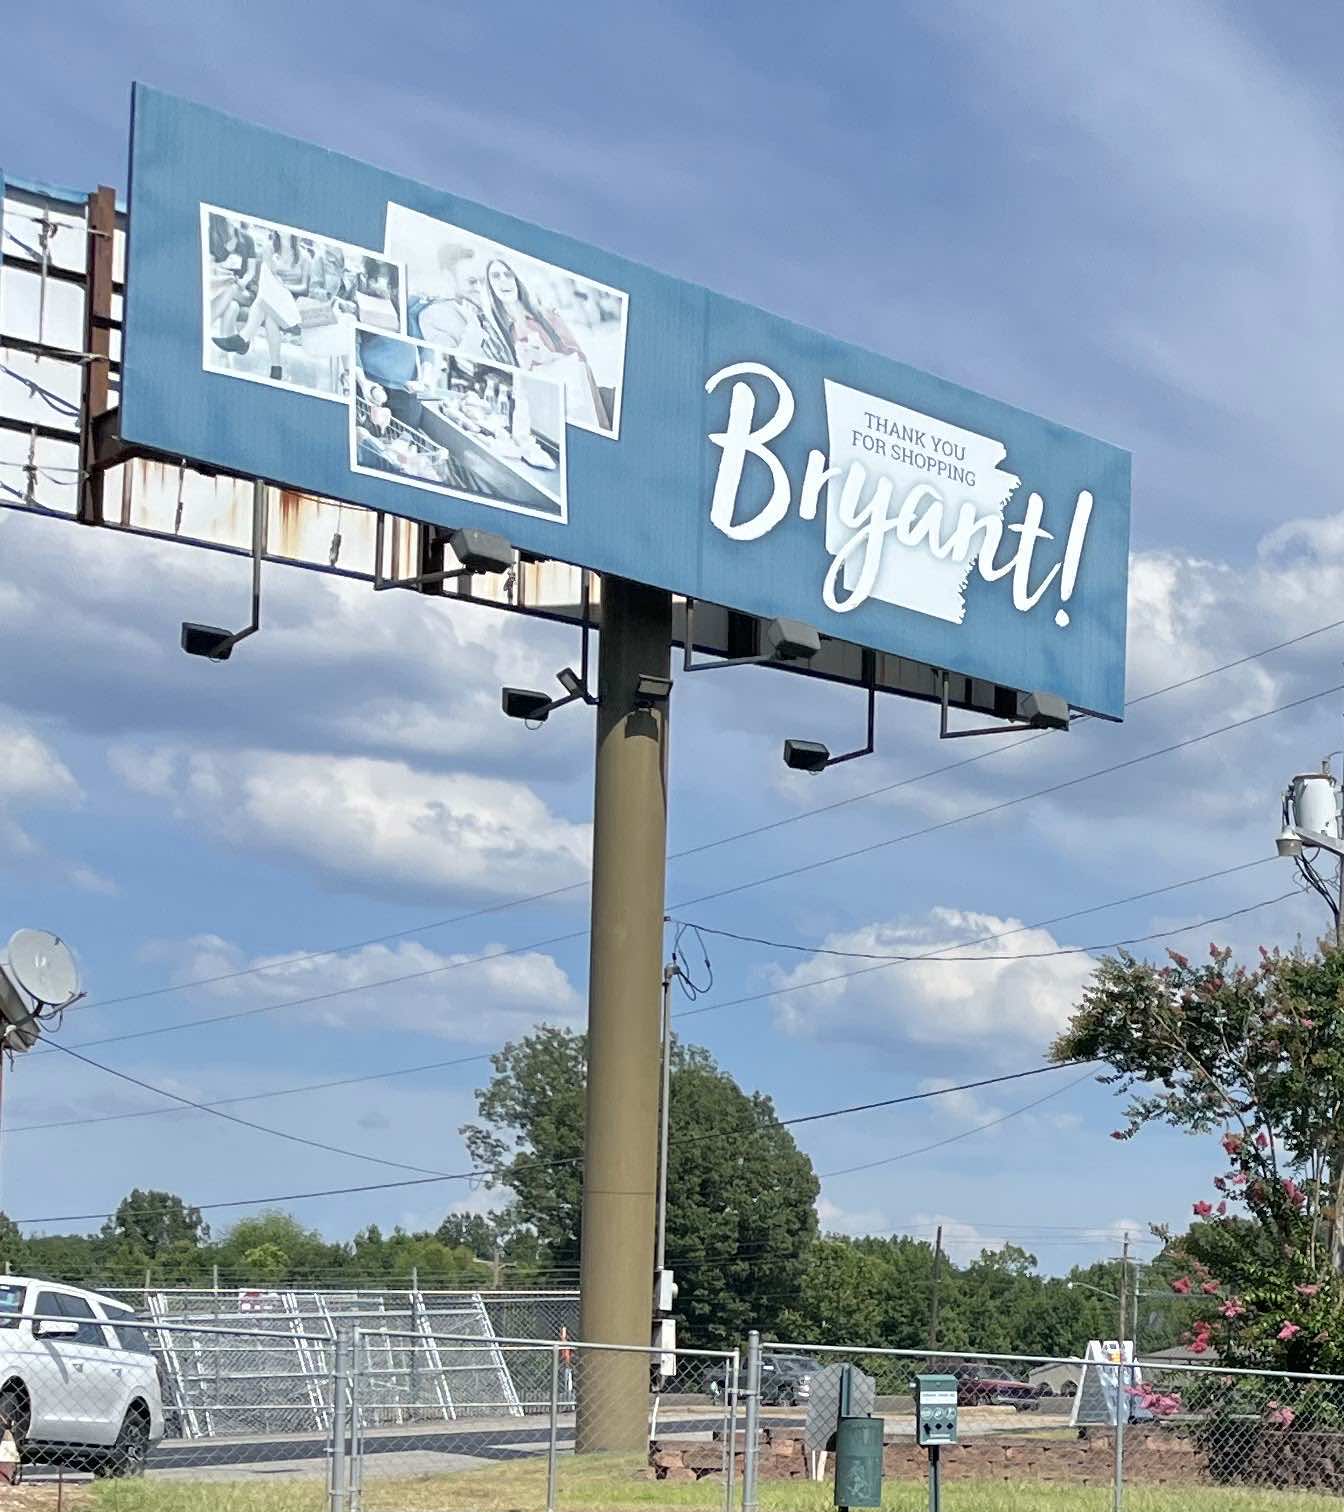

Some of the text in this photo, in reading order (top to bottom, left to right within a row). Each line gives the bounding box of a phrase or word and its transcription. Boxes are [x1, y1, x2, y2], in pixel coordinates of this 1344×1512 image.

[852, 430, 976, 486] FOR SHOPPING
[864, 411, 966, 461] THANK YOU
[705, 362, 1093, 627] Bryant!
